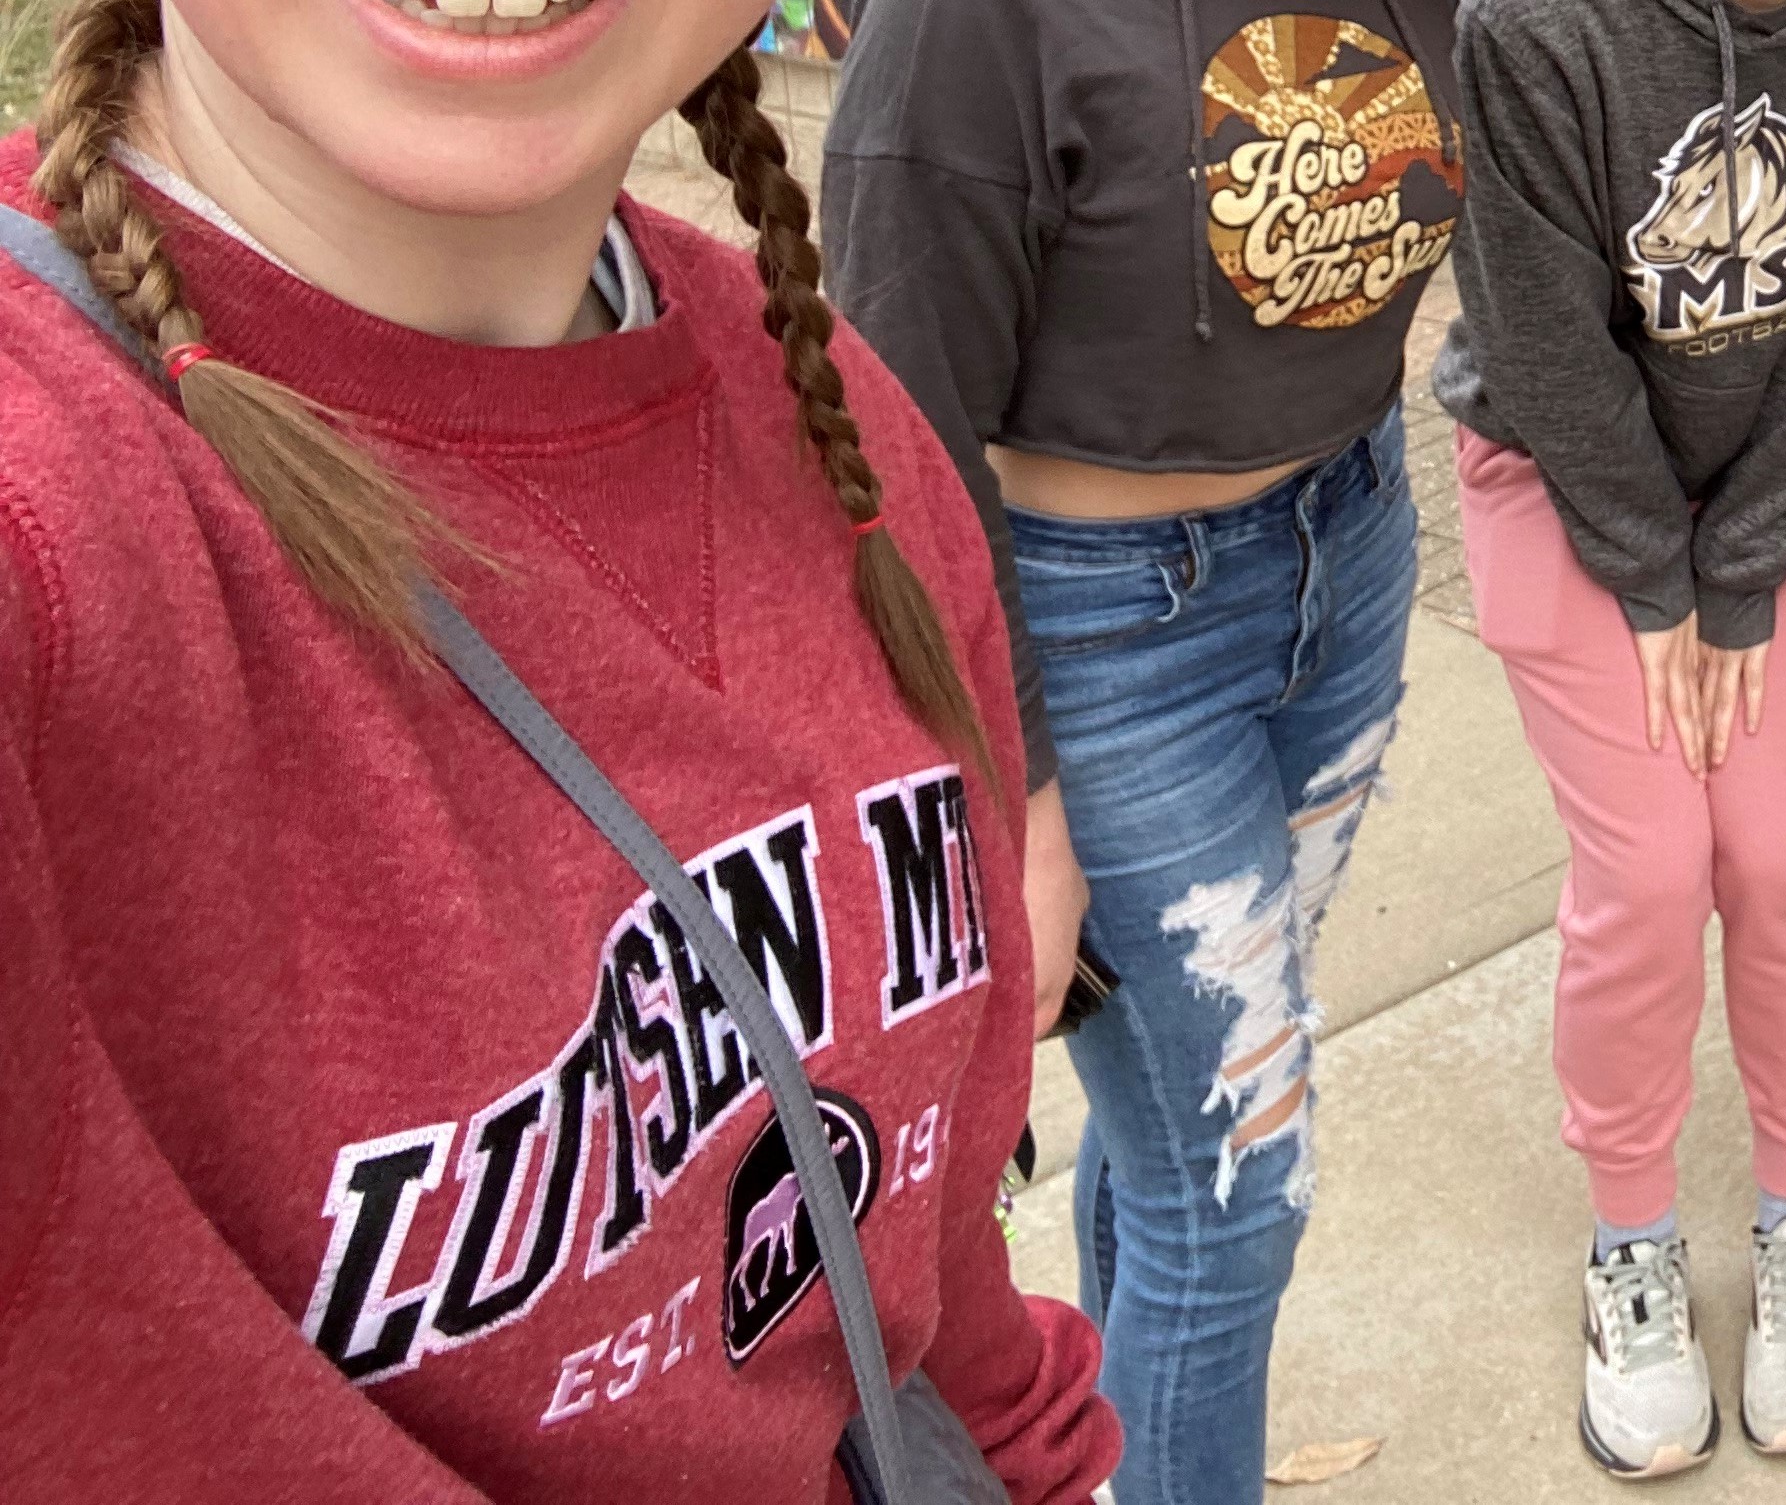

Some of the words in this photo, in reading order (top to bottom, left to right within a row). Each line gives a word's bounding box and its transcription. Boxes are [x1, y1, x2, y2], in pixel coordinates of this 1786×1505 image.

[1211, 120, 1365, 226] Here
[1246, 192, 1400, 279] Comes
[1254, 244, 1364, 327] The
[1363, 221, 1451, 299] Sun
[302, 804, 833, 1387] LUTSEN
[855, 763, 992, 1032] MT
[888, 1102, 950, 1199] 19
